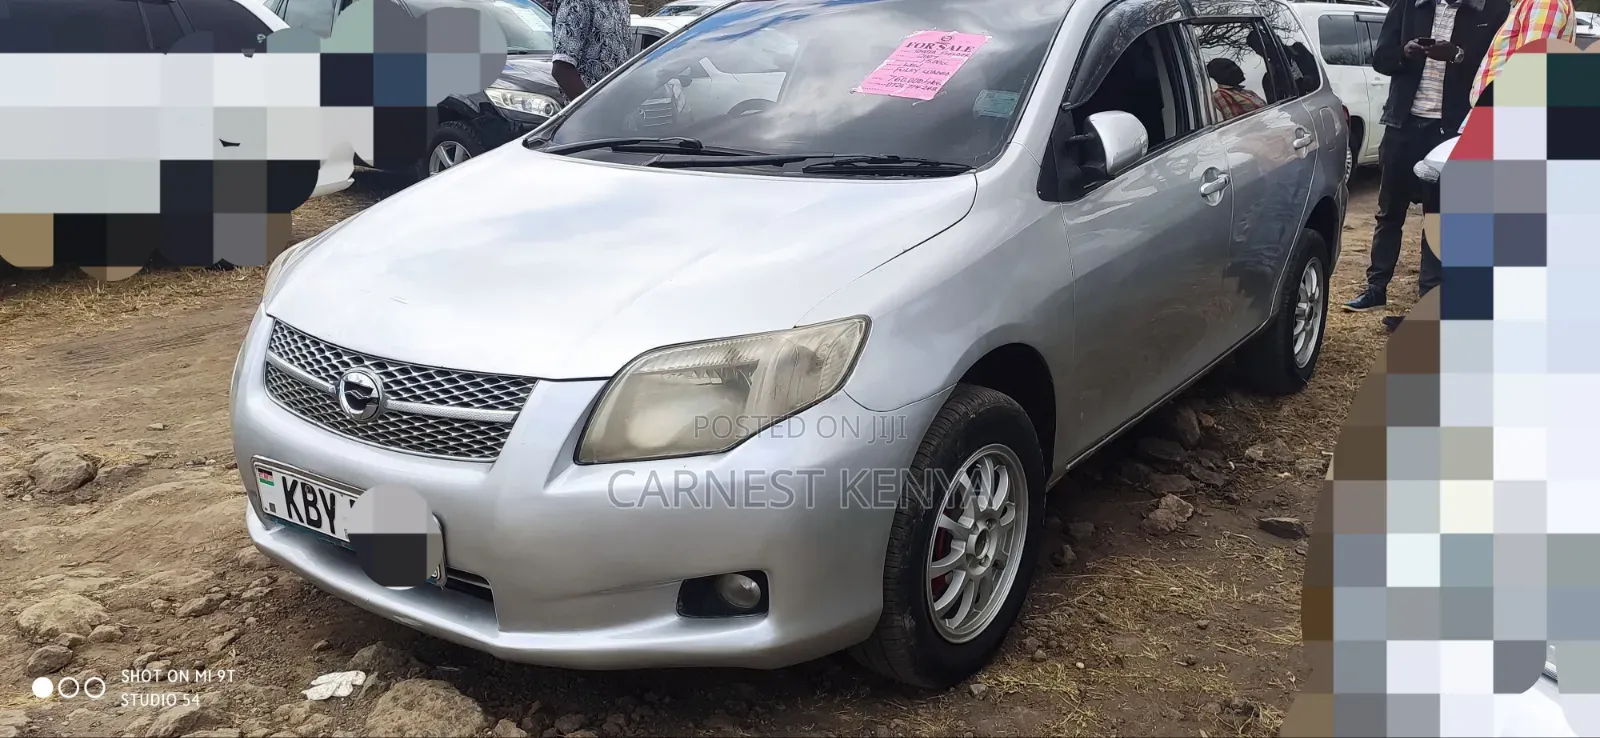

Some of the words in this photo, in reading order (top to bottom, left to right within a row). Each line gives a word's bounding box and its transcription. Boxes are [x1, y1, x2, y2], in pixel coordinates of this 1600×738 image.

[905, 42, 935, 50] FOR
[936, 44, 975, 53] SALE
[281, 475, 336, 535] KBY
